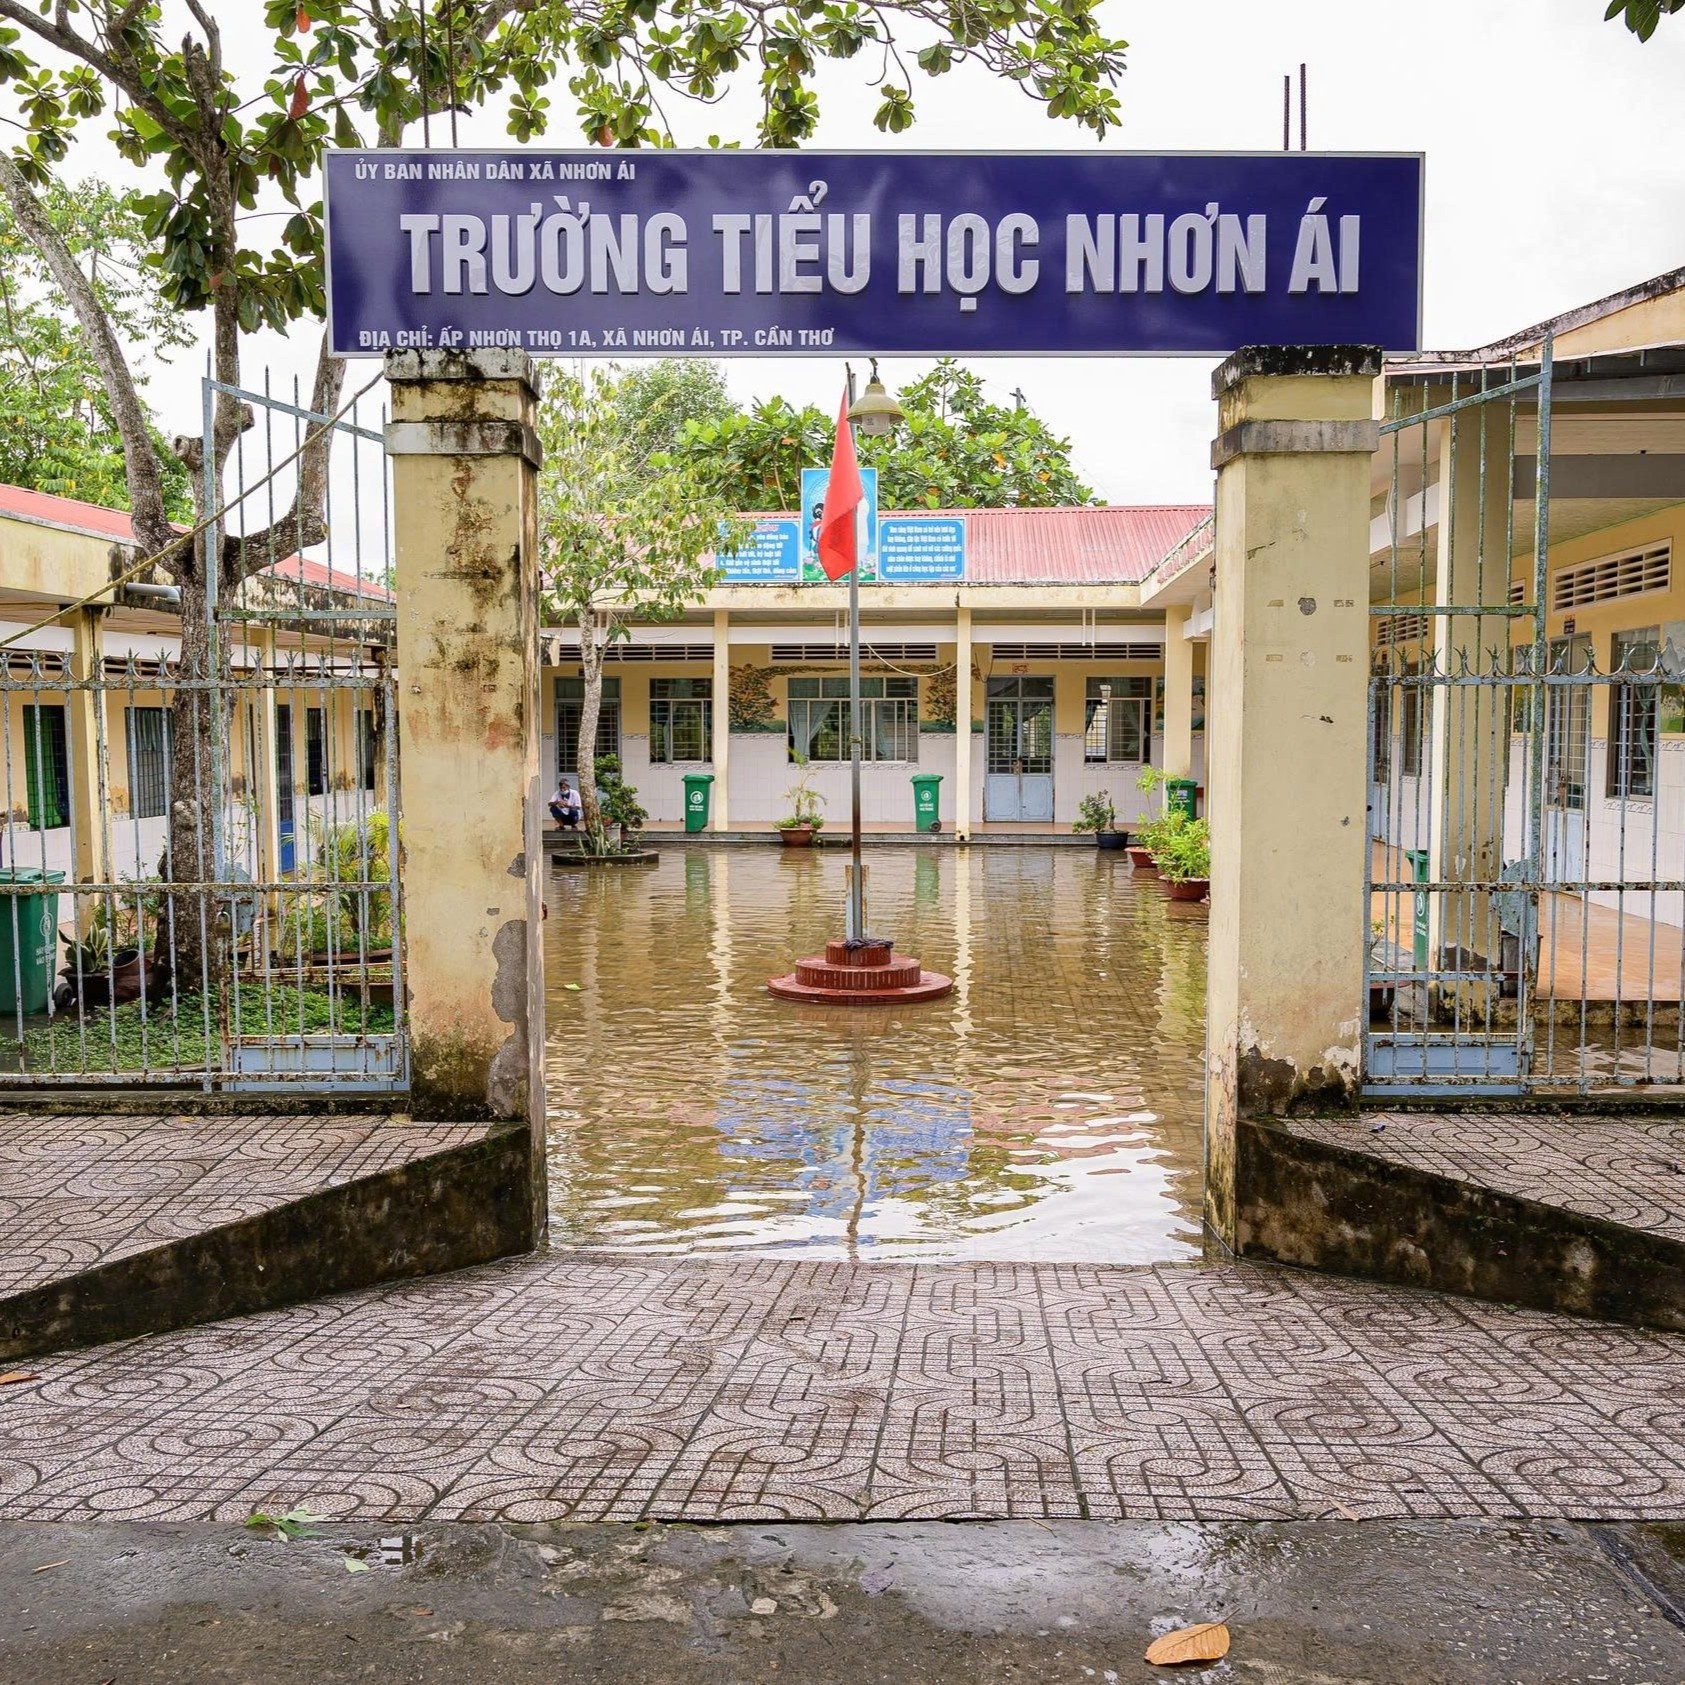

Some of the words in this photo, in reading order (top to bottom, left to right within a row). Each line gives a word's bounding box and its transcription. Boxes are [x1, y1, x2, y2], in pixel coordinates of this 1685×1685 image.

[355, 158, 378, 180] ỦY
[384, 163, 422, 180] BAN
[428, 161, 480, 180] NHÂN
[486, 161, 525, 180] DÂN
[529, 161, 554, 180] XÃ
[559, 161, 612, 180] NHƠN
[617, 160, 636, 180] ÁI
[400, 195, 688, 295] TRƯỜNG
[712, 180, 870, 295] TIỂU
[898, 212, 1040, 312] HỌC
[1066, 202, 1267, 294] NHƠN
[1288, 197, 1360, 294] ÁI
[359, 330, 391, 350] ĐỊA
[397, 326, 433, 346] CHỈ:
[439, 326, 464, 346] ẤP
[469, 329, 521, 346] NHƠN
[527, 330, 562, 350] THỌ
[568, 330, 597, 348] 1A,
[602, 327, 627, 346] XÃ
[633, 328, 685, 346] NHƠN
[691, 327, 715, 348] ÁI,
[720, 330, 748, 346] TP.
[754, 325, 792, 346] CẦN
[798, 328, 834, 346] THƠ
